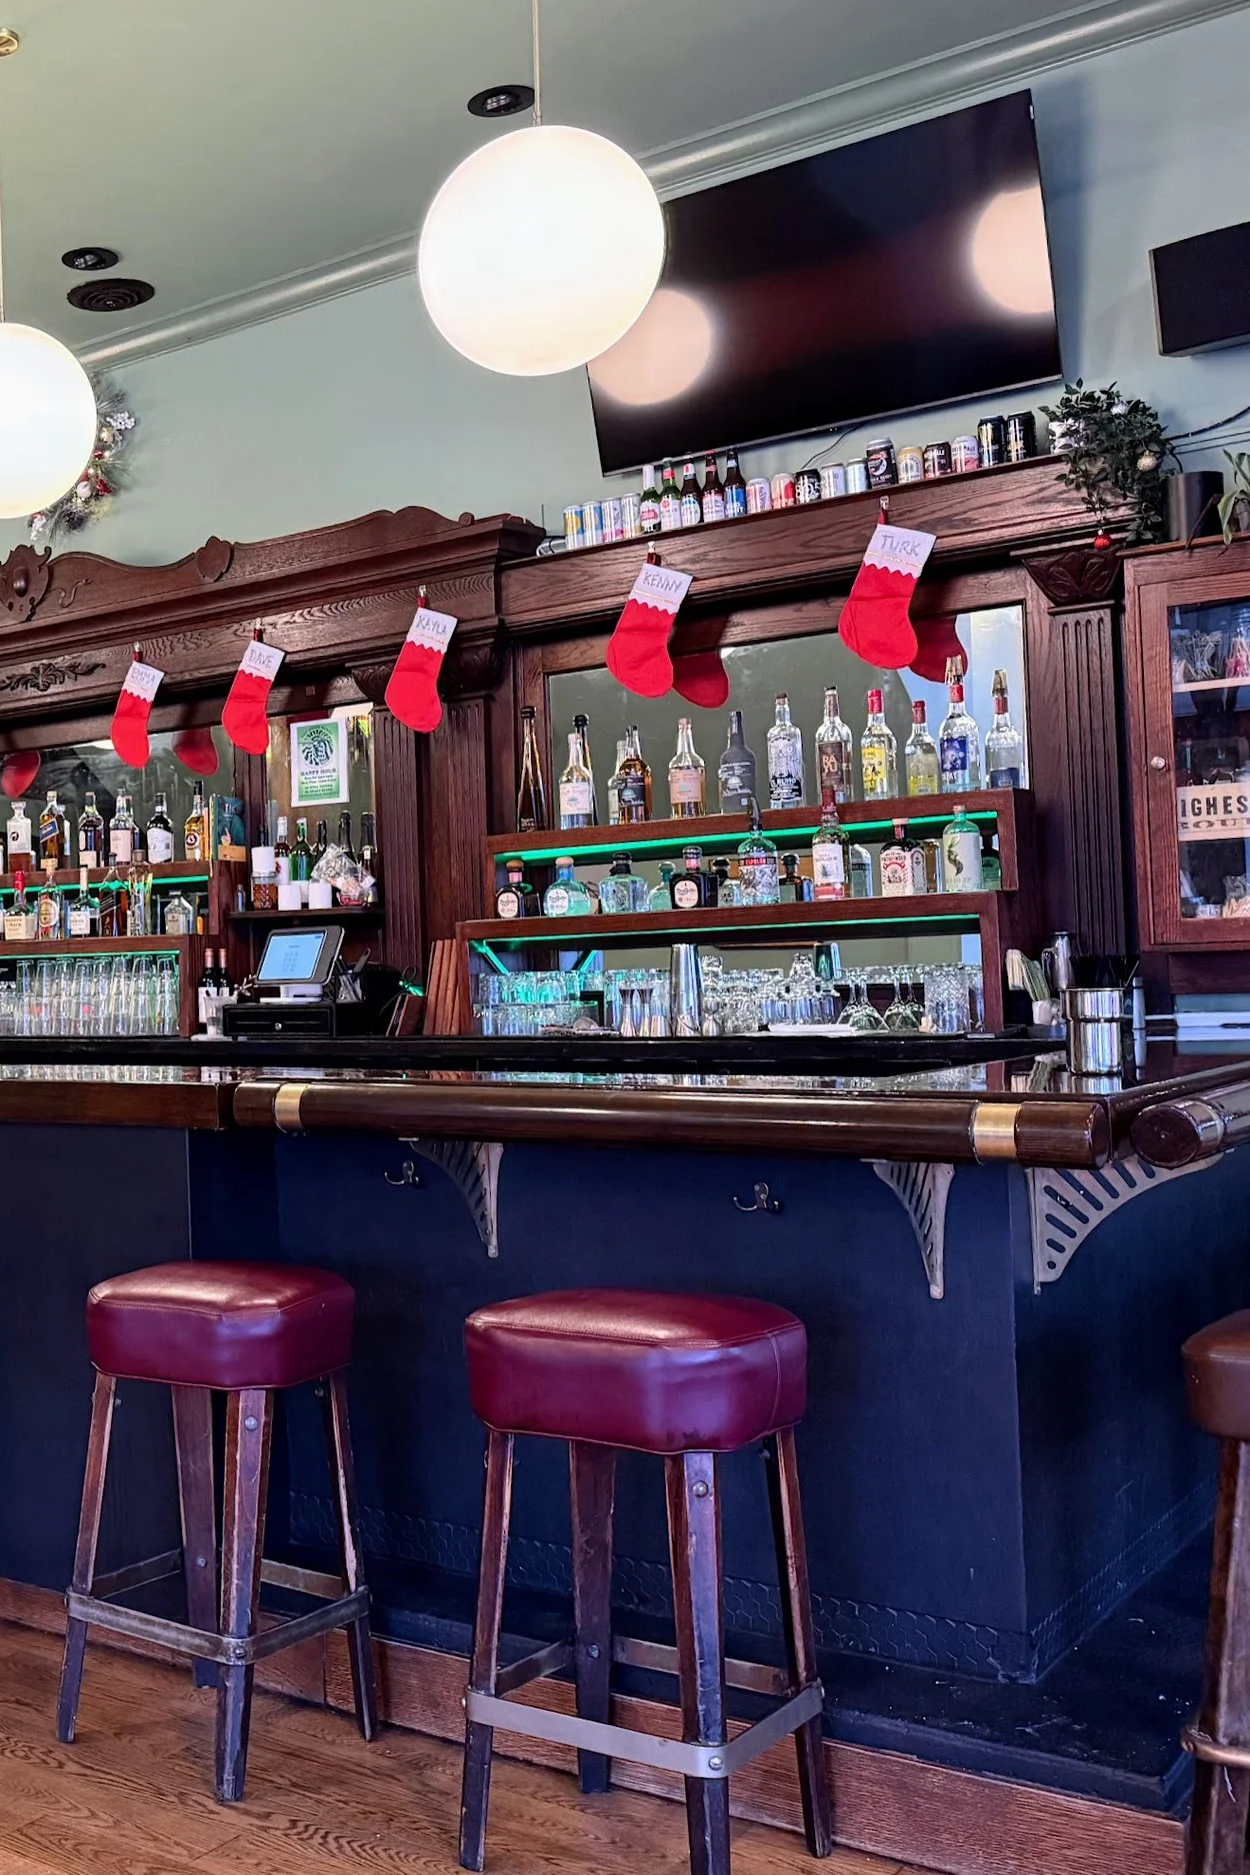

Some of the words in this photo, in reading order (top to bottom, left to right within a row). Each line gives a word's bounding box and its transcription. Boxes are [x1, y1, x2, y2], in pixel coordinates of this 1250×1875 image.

[882, 534, 921, 557] TURK
[643, 572, 683, 593] KENNY
[416, 615, 448, 636] KAYLA
[249, 649, 274, 669] DAVE
